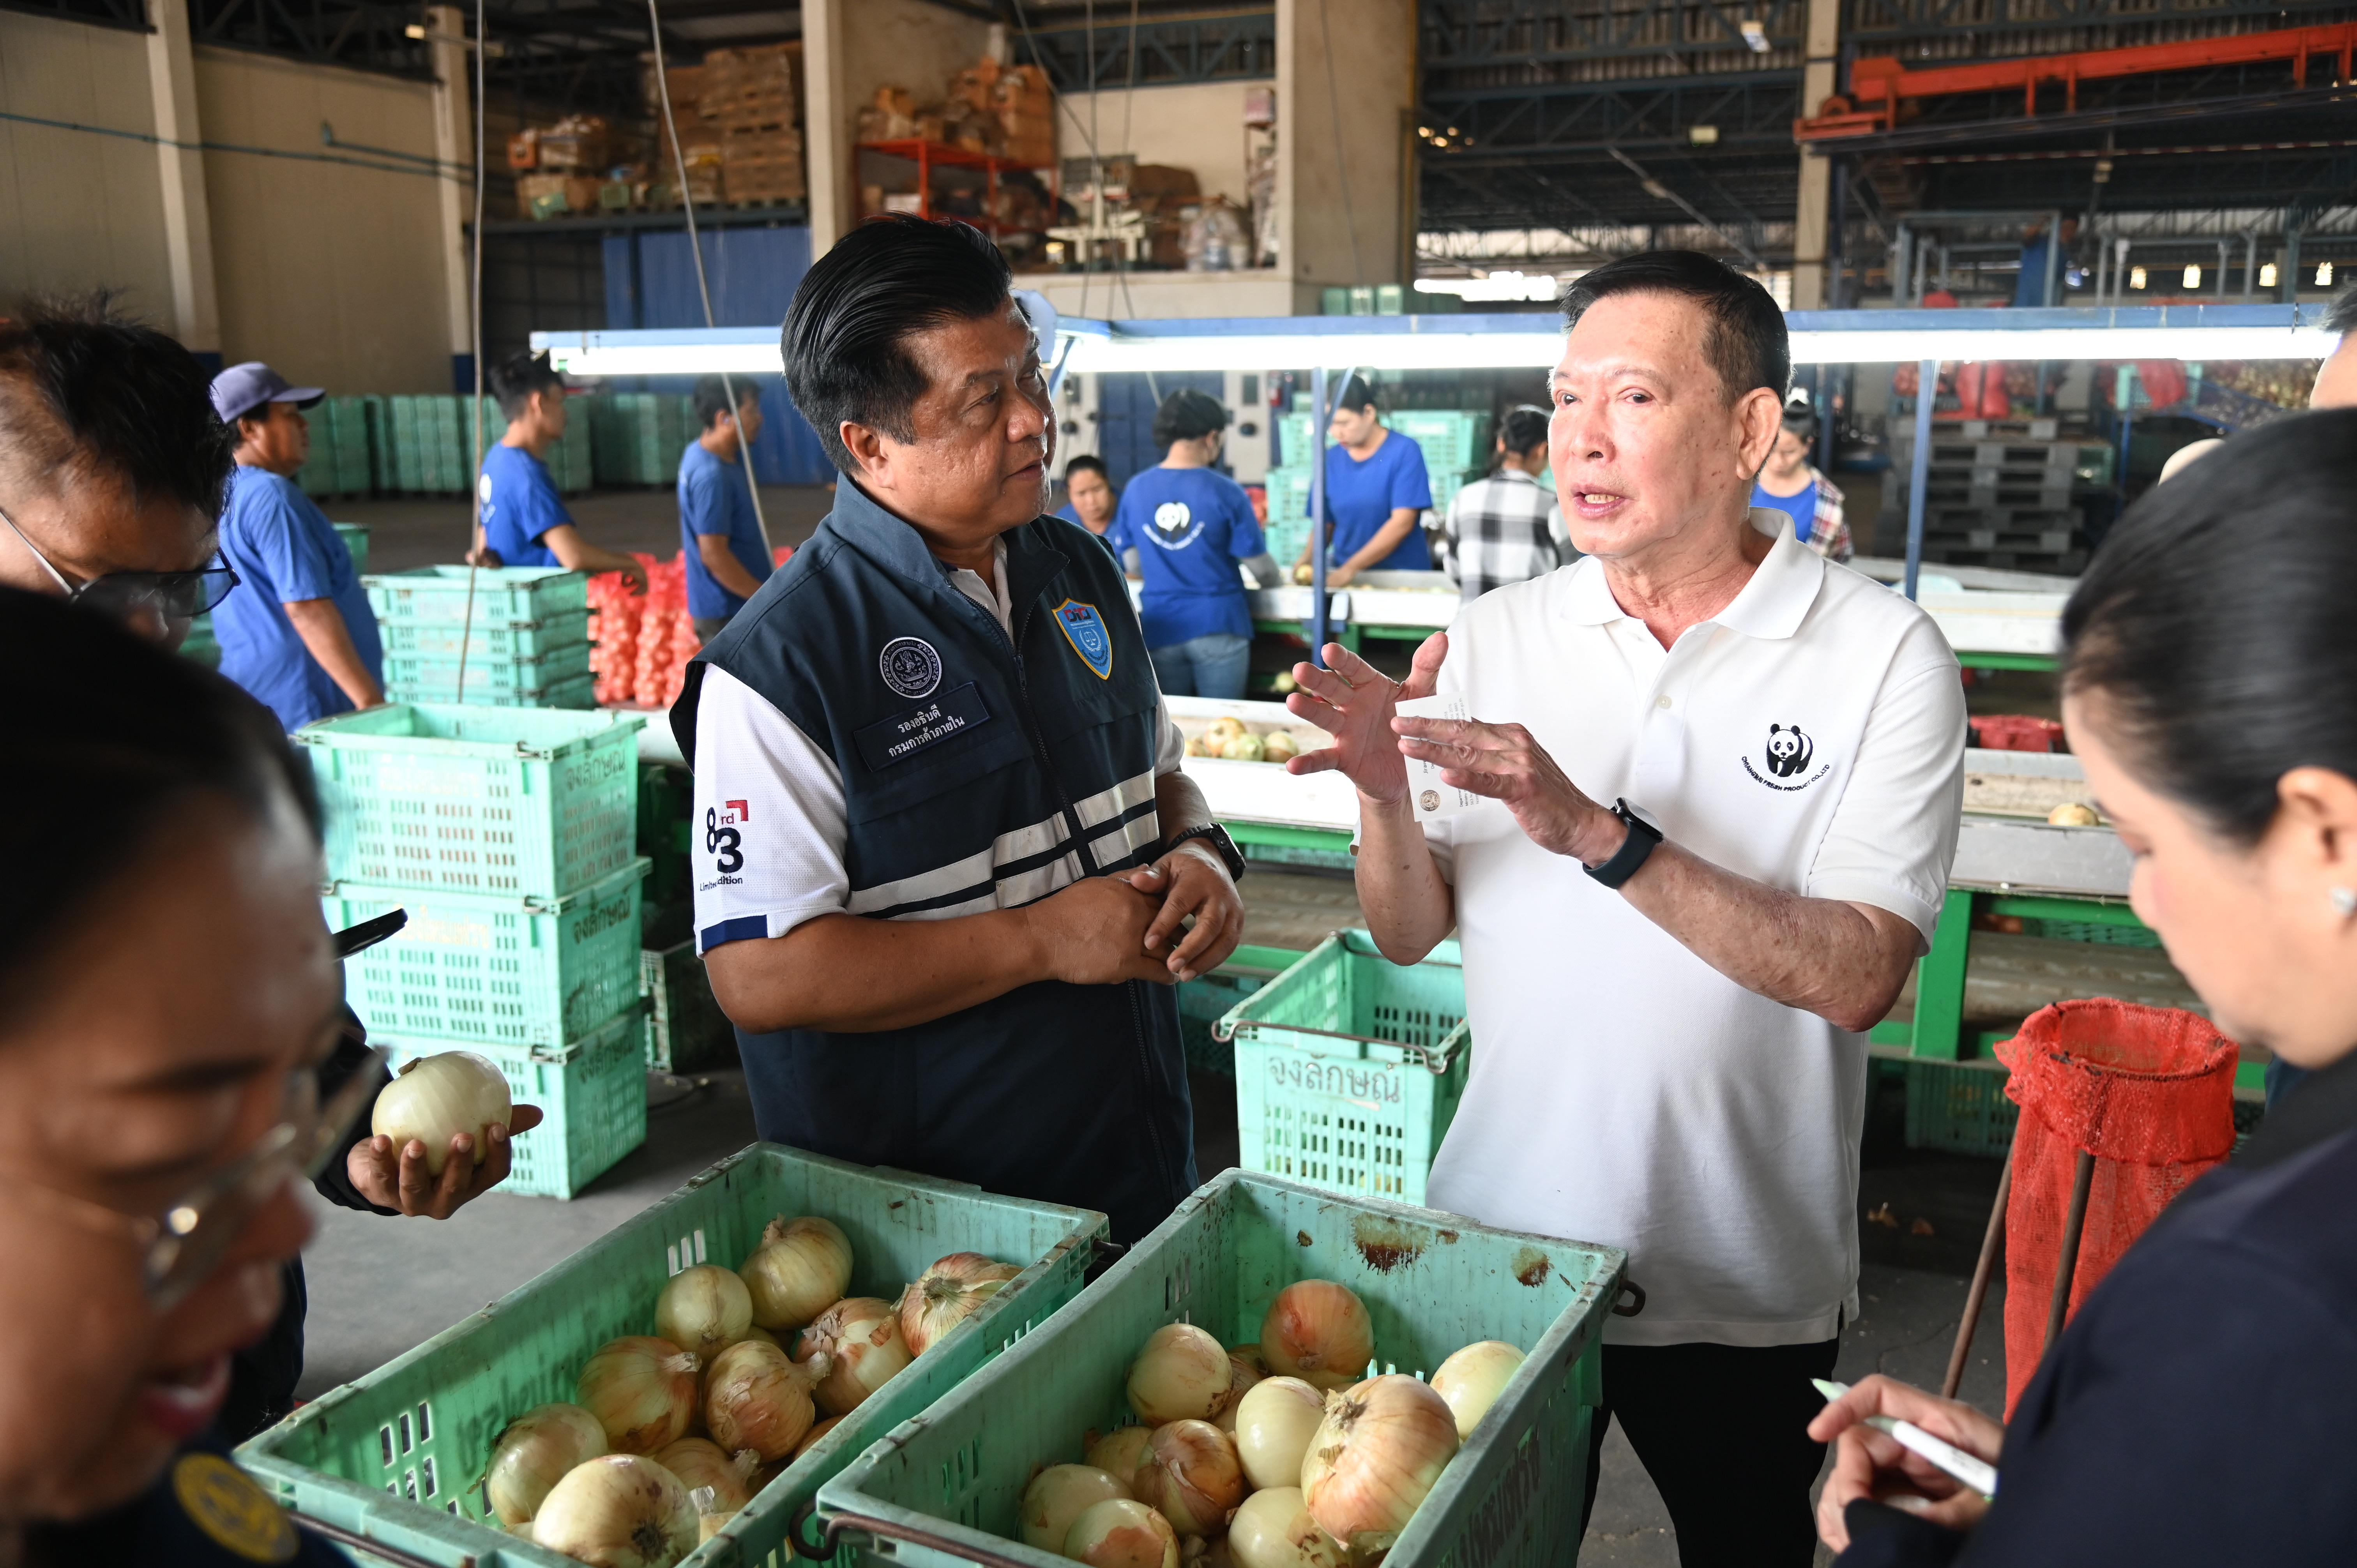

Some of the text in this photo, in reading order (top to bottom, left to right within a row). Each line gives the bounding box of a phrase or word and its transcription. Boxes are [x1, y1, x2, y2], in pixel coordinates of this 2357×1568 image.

[898, 704, 941, 733] รองอธิบดี
[889, 716, 965, 757] กรมการค้าภายใน
[1742, 756, 1764, 783] CHIANGMAI
[1763, 780, 1783, 791] FRESH
[1783, 780, 1811, 791] PRODUCT
[717, 876, 743, 885] dition
